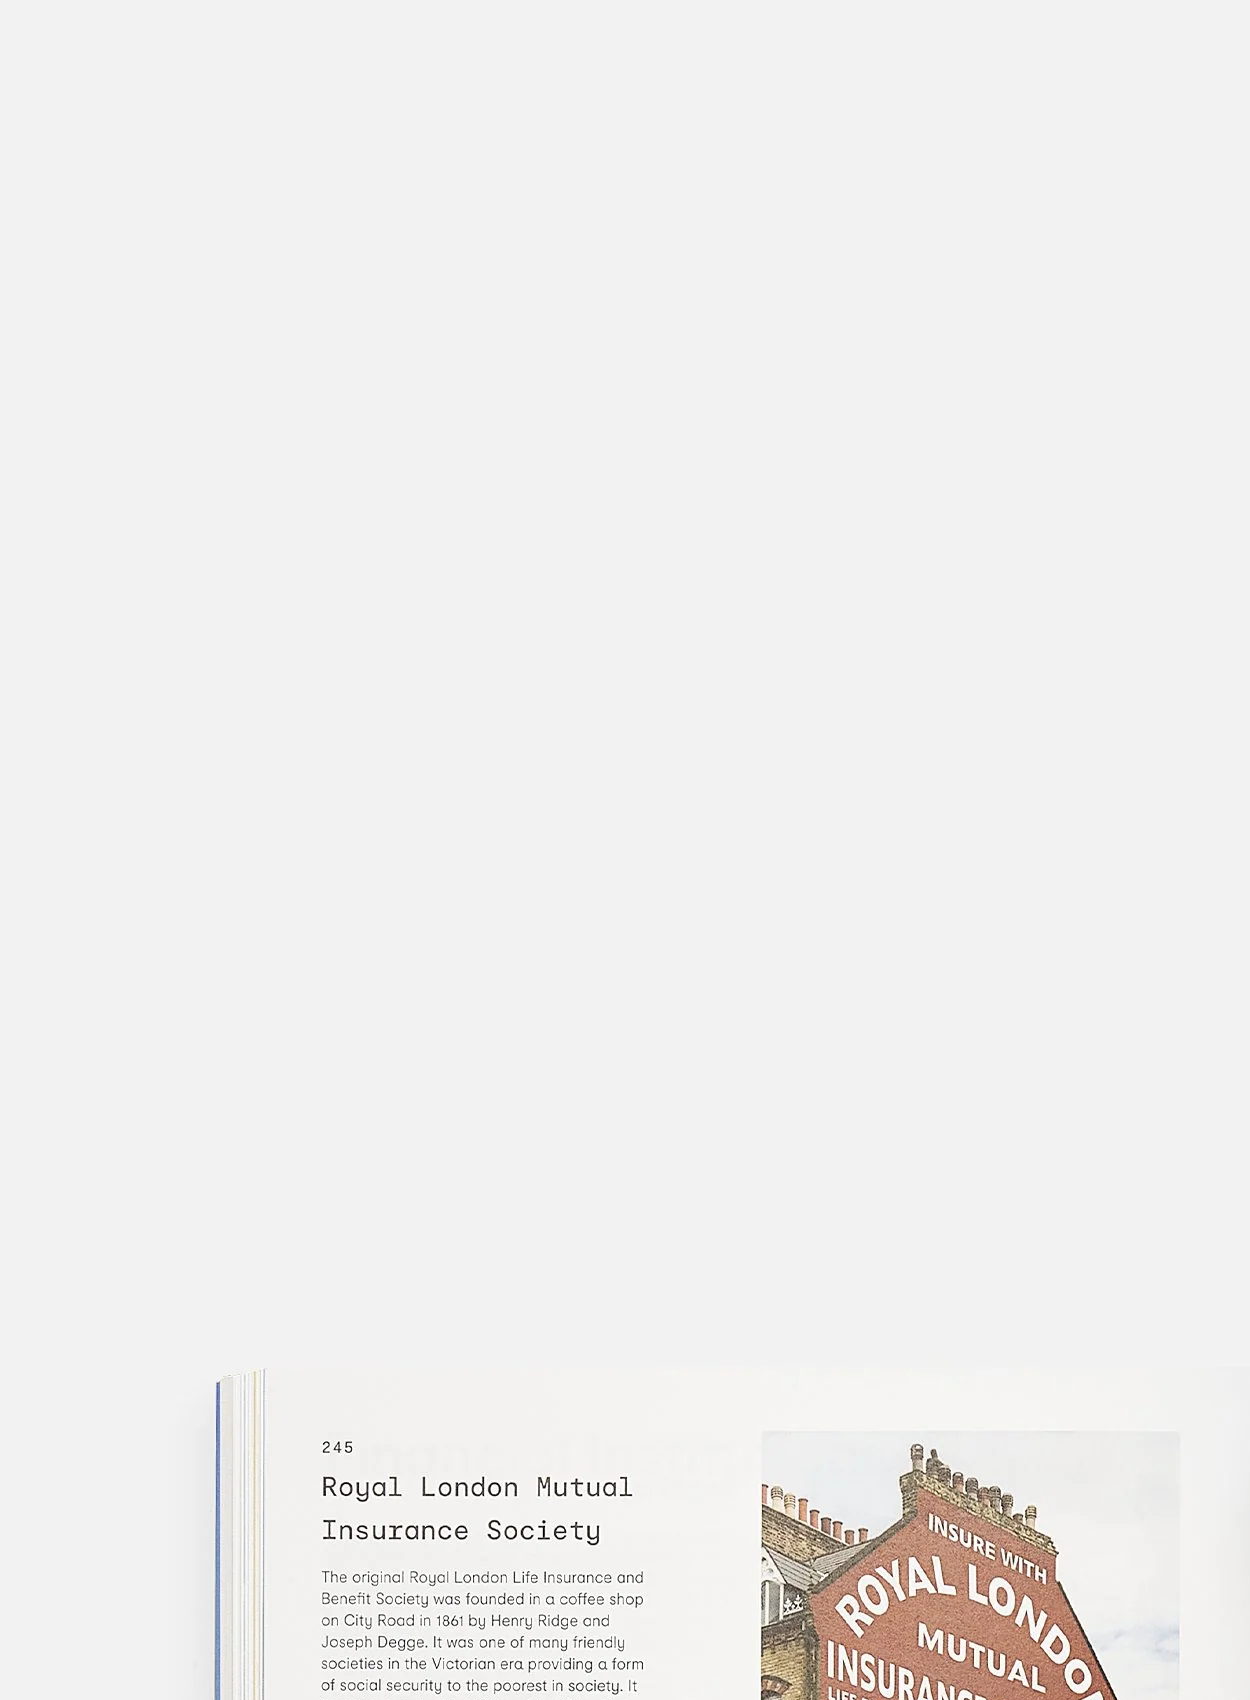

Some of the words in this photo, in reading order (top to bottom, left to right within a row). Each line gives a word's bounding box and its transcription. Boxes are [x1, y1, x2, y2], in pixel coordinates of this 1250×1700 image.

[322, 1440, 353, 1454] 245
[322, 1476, 403, 1503] Royal
[421, 1475, 518, 1498] London
[537, 1476, 633, 1498] Mutual
[322, 1519, 469, 1541] Insurance
[486, 1519, 600, 1546] Society
[928, 1512, 996, 1561] INSURE
[1000, 1547, 1047, 1584] WITH
[321, 1570, 348, 1584] The
[351, 1570, 405, 1587] original
[409, 1570, 449, 1587] Royal
[454, 1570, 508, 1584] London
[512, 1570, 539, 1584] Life
[543, 1570, 613, 1584] Insurance
[616, 1570, 644, 1584] and
[321, 1591, 372, 1606] Benefit
[375, 1591, 429, 1609] Society
[432, 1595, 461, 1606] was
[465, 1592, 525, 1606] founded
[529, 1592, 541, 1606] in
[545, 1595, 556, 1606] a
[559, 1591, 605, 1606] coffee
[609, 1592, 644, 1609] shop
[835, 1555, 957, 1639] ROYAL
[917, 1622, 1047, 1694] MUTUAL
